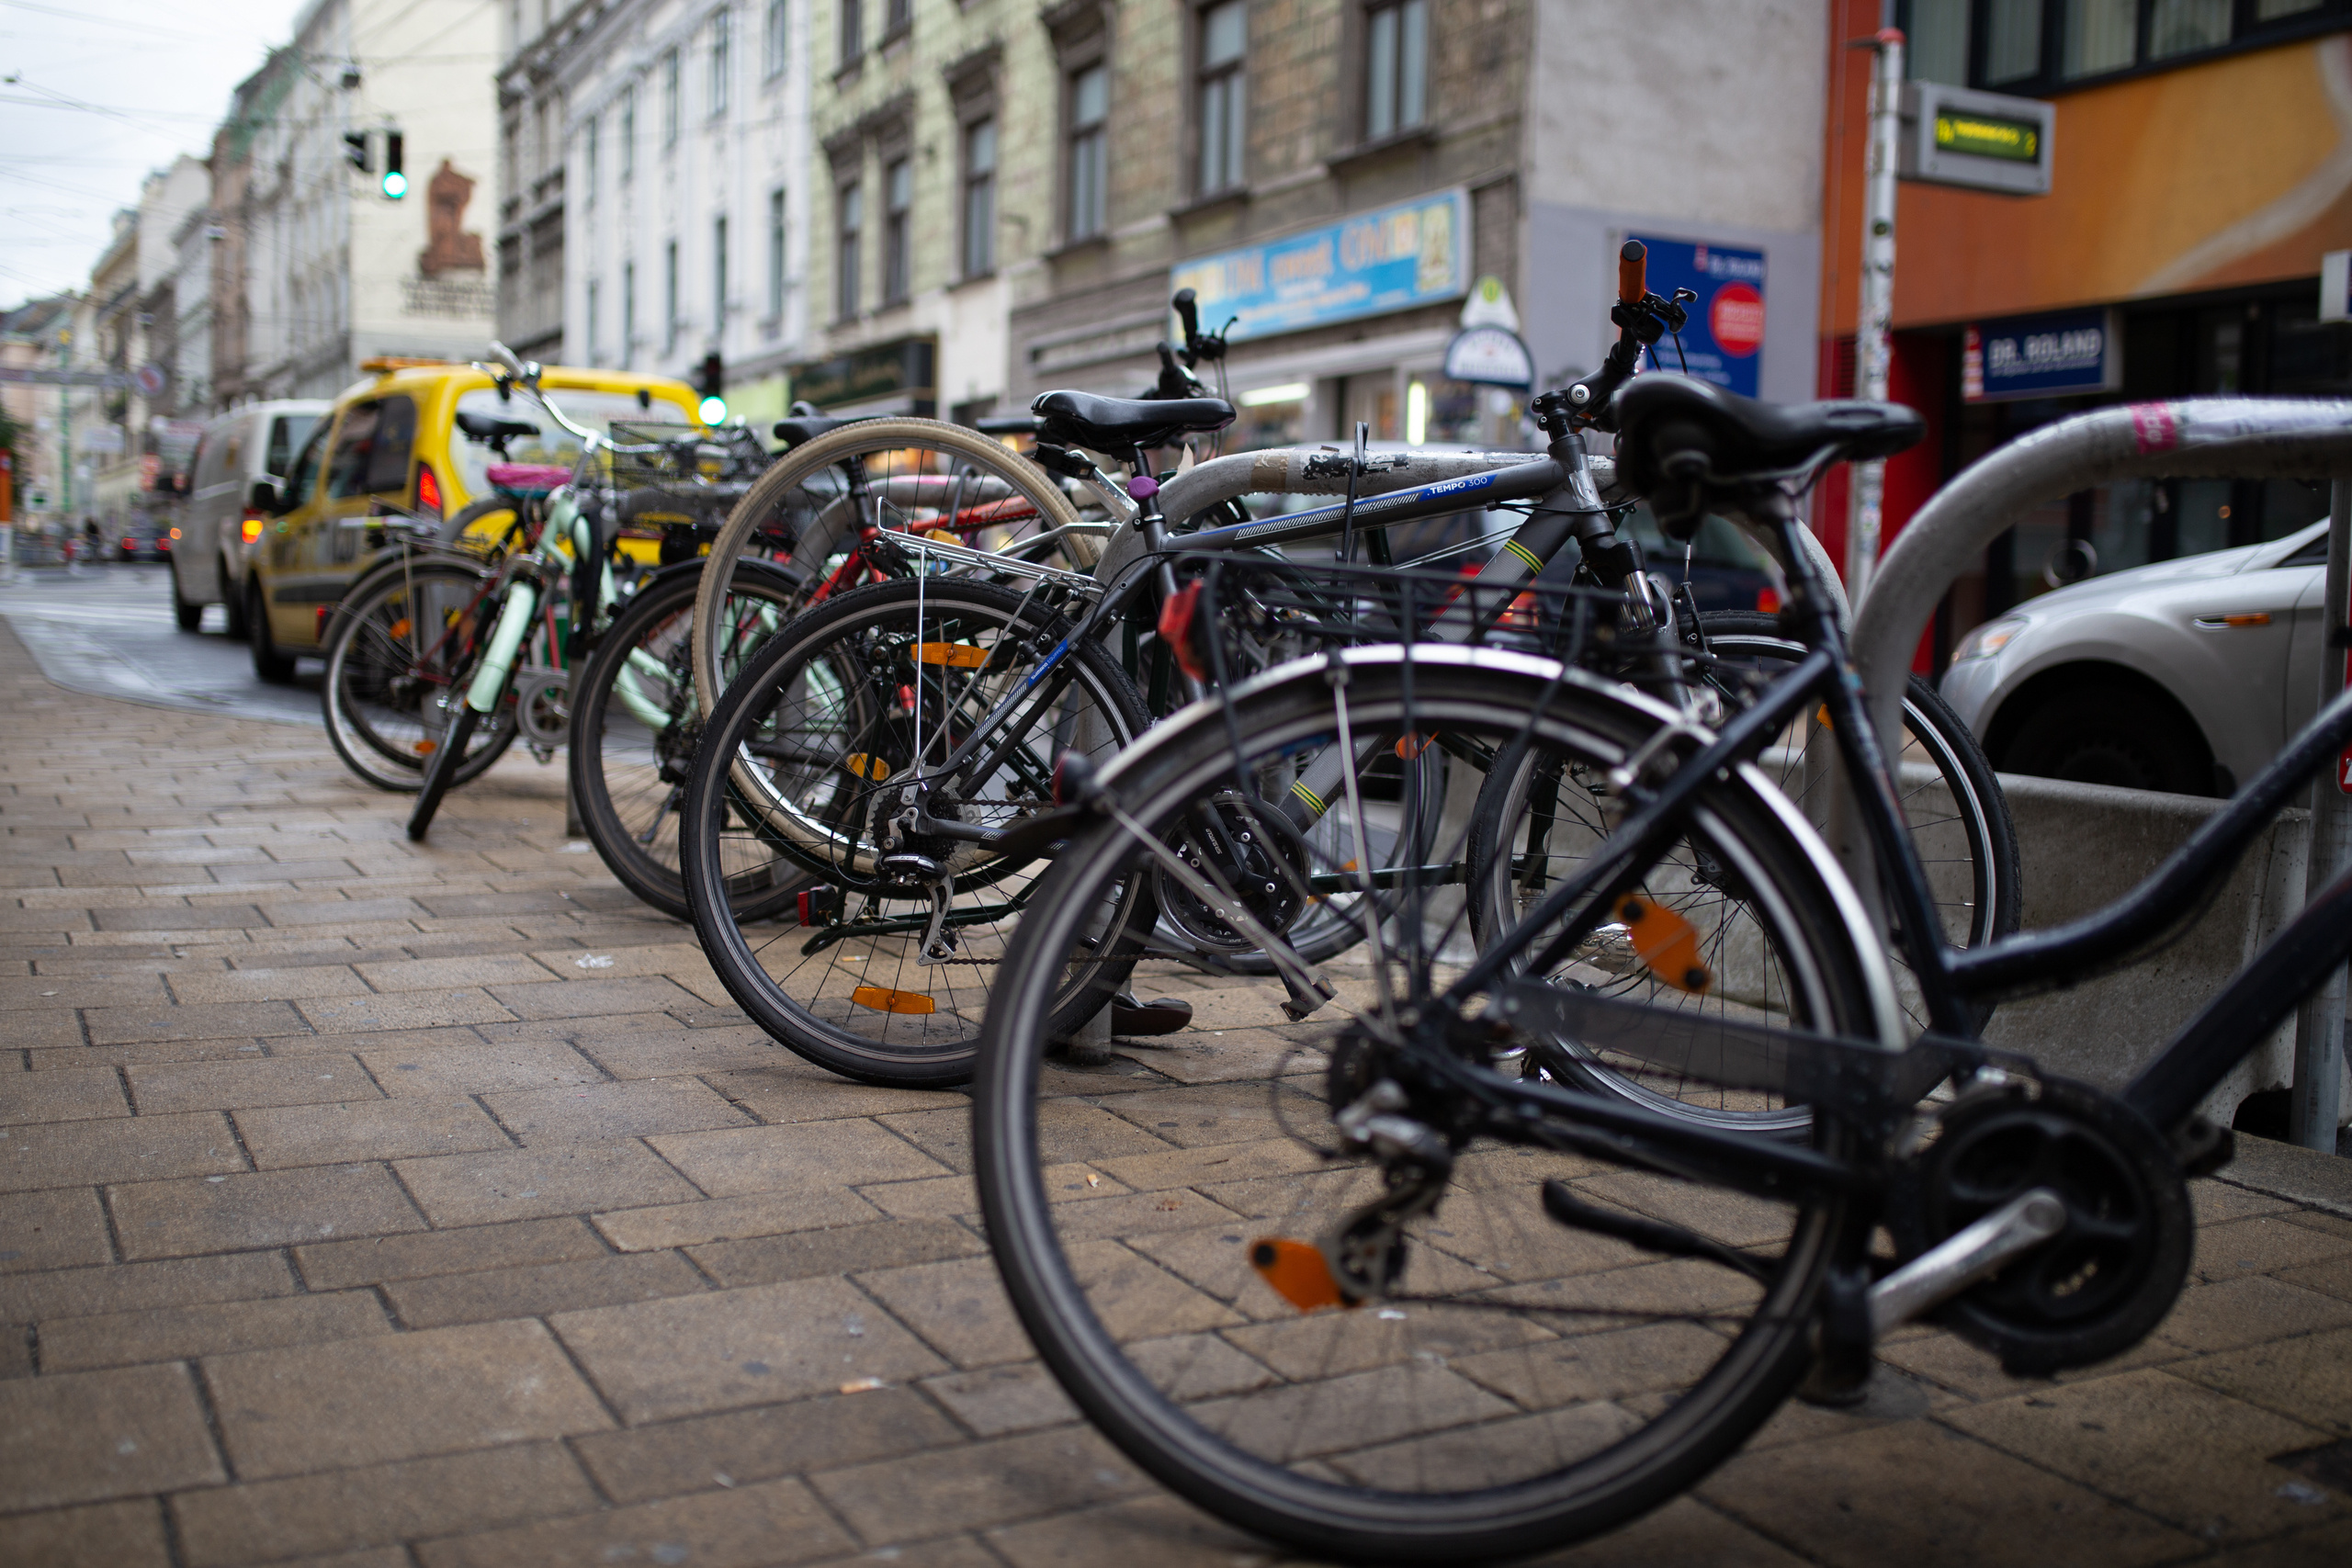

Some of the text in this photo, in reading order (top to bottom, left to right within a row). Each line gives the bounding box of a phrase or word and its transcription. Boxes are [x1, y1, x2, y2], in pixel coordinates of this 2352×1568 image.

[2024, 328, 2103, 364] ROLAND
[1430, 476, 1487, 494] TEMPO 300
